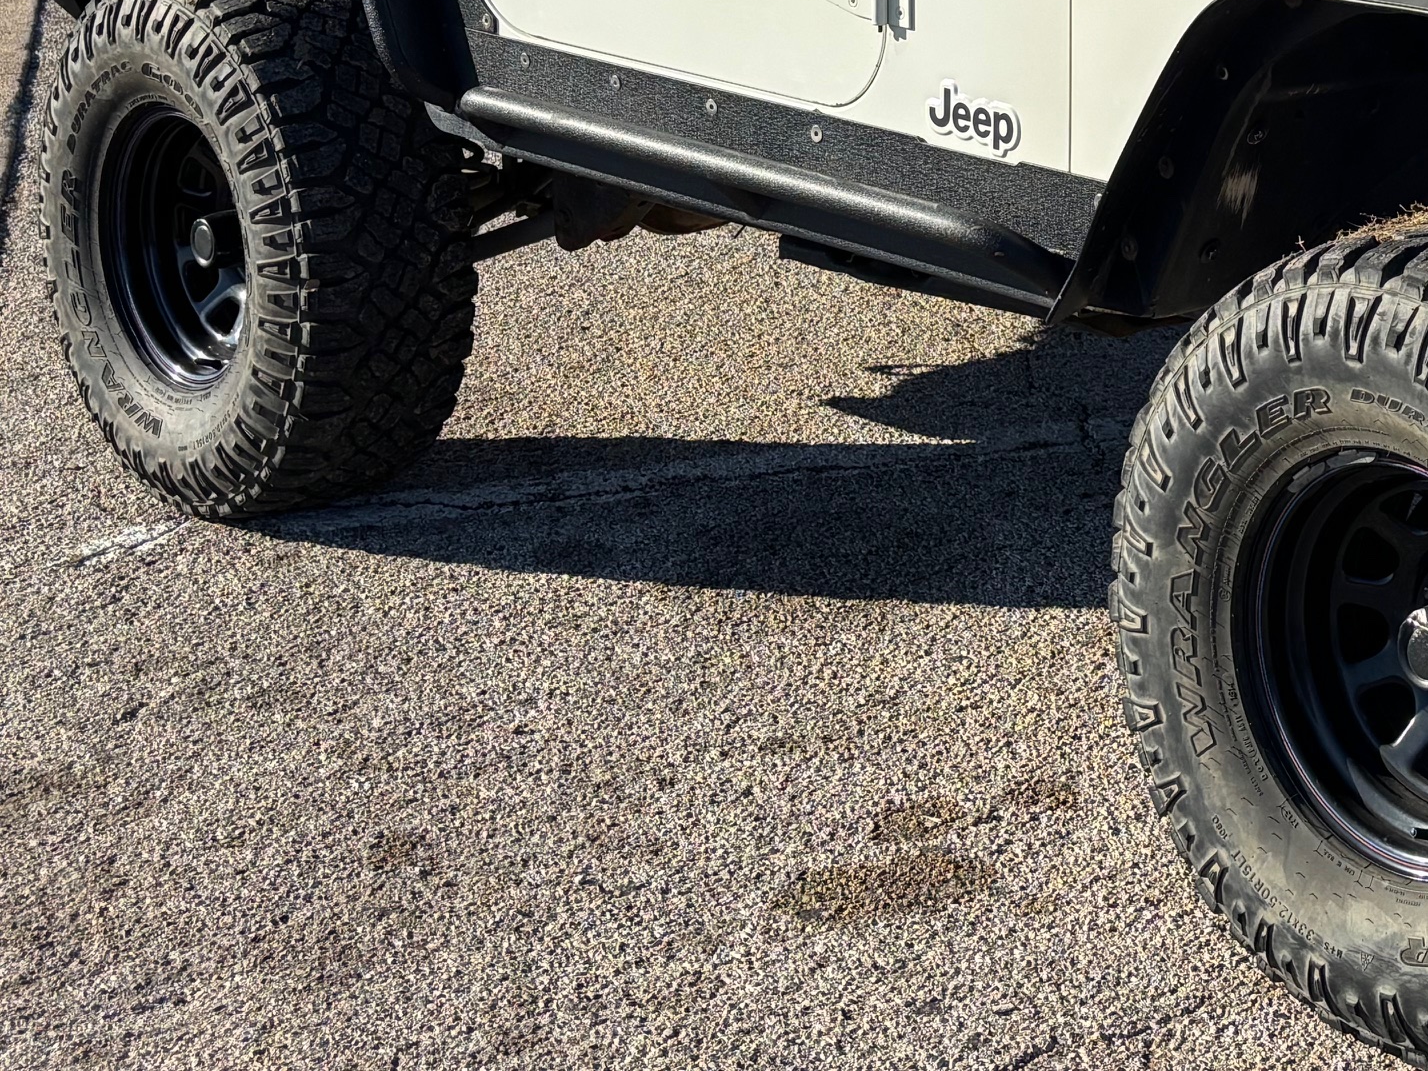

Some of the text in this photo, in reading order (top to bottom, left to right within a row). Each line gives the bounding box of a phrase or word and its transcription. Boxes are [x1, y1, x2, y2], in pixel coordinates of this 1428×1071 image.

[929, 86, 1013, 150] Jeep
[60, 168, 164, 439] WRANGLER
[1169, 387, 1333, 758] WRANGLER
[1230, 849, 1315, 944] 33X12.50R15LT
